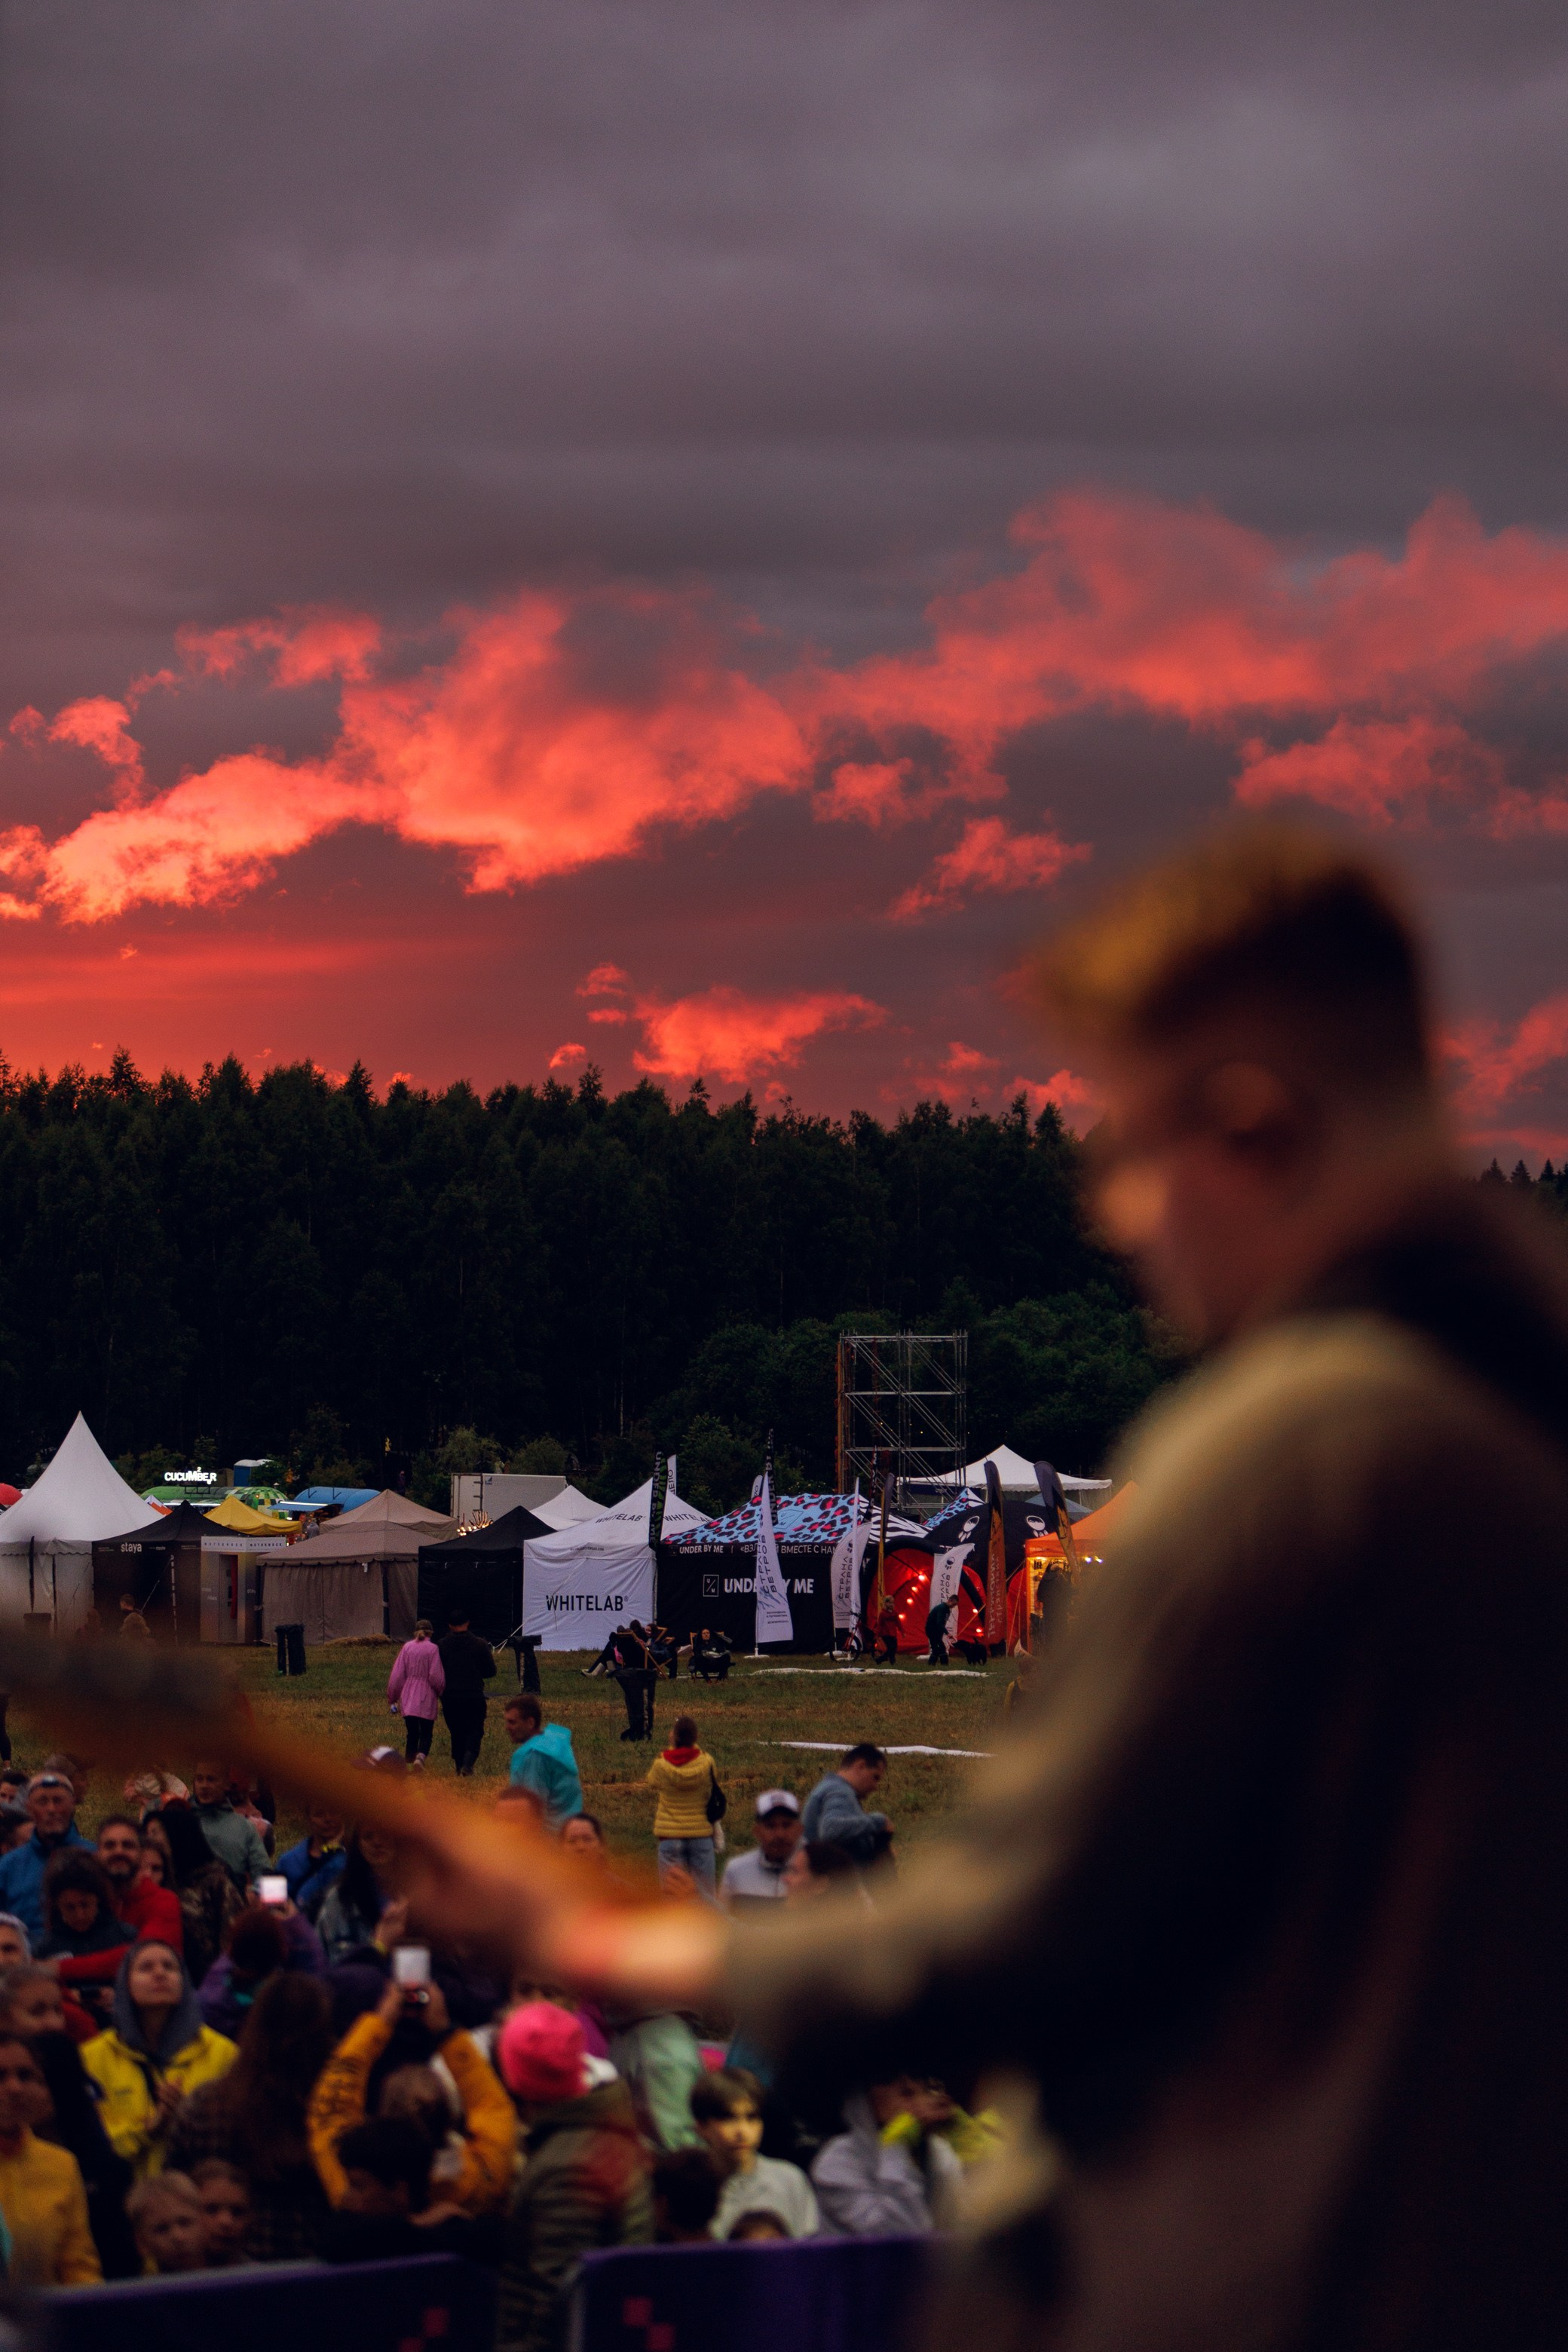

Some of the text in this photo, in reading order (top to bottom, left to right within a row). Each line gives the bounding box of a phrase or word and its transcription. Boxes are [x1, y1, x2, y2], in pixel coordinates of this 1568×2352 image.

[595, 1513, 643, 1524] WHITELAB
[121, 1542, 142, 1553] staya
[679, 1545, 702, 1554] UNDER
[781, 1545, 812, 1554] ВМЕСТЕ
[761, 1535, 777, 1593] ВЕТРОВ
[838, 1556, 849, 1599] СТРАНА
[724, 1578, 757, 1593] UND
[794, 1579, 814, 1594] ME
